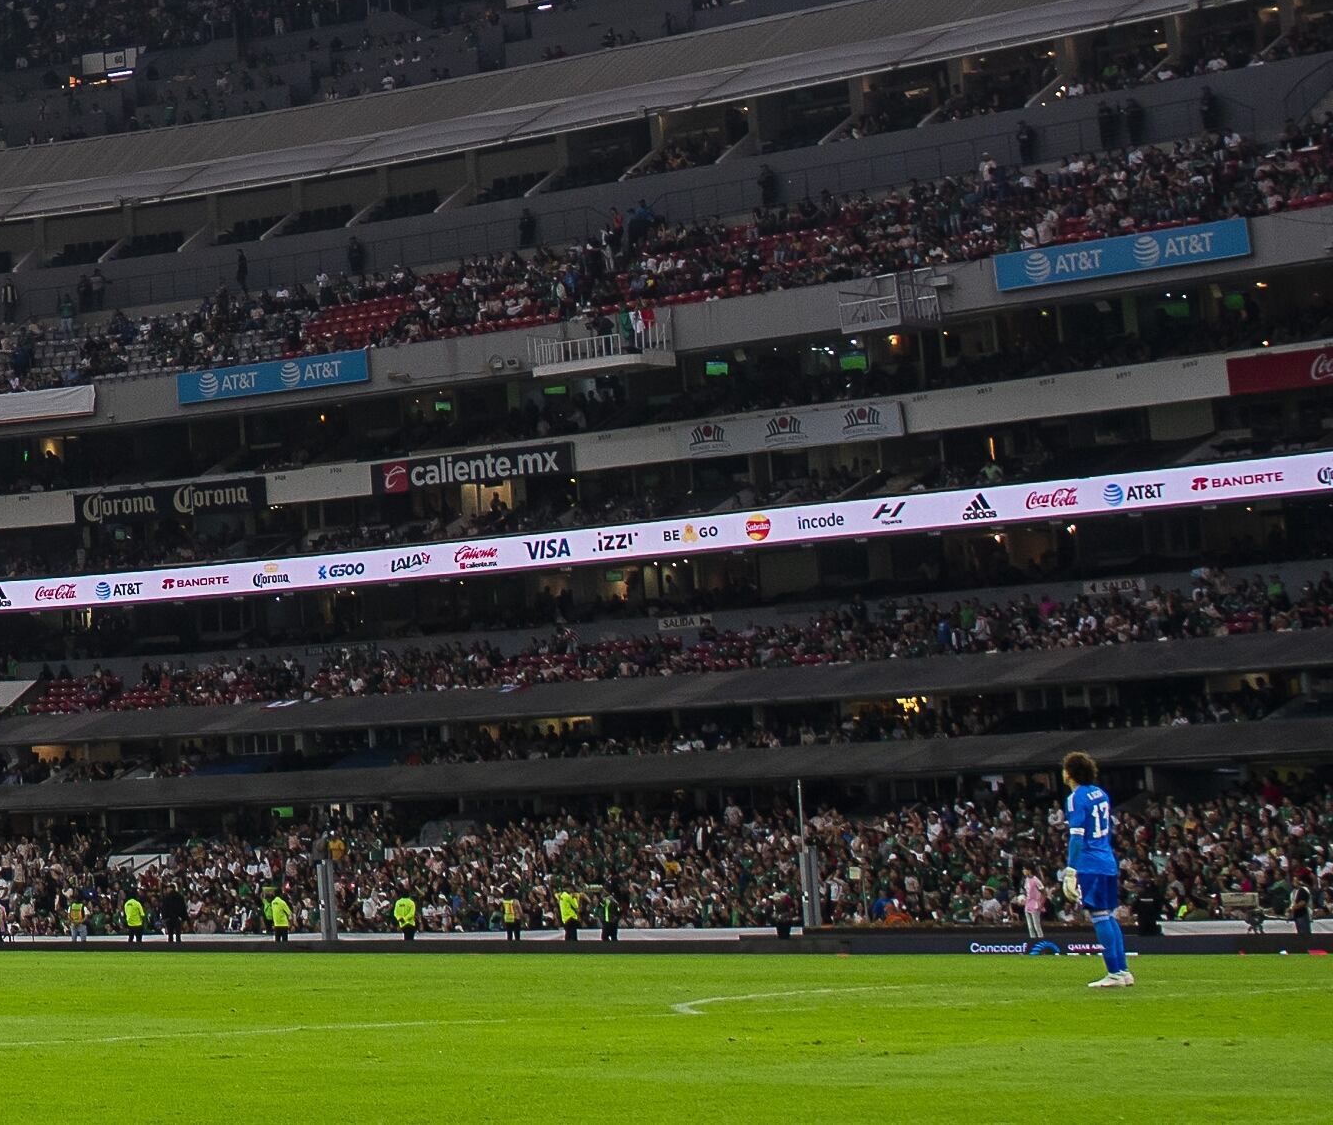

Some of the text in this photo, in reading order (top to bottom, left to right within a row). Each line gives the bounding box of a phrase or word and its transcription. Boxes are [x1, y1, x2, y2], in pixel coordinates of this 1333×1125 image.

[1165, 232, 1213, 257] AT&T
[1055, 249, 1102, 274] AT&T
[304, 361, 341, 381] AT&T
[221, 372, 257, 391] AT&T
[412, 450, 558, 488] caliente.mx
[1212, 472, 1284, 488] BANORTE
[173, 484, 250, 515] Corona
[1127, 483, 1165, 500] AT&T
[83, 495, 156, 523] Corona
[962, 510, 998, 520] adidas
[797, 512, 844, 530] incode
[522, 538, 571, 560] VISA
[329, 563, 365, 577] G500
[113, 582, 143, 597] AT&T
[177, 576, 229, 588] BANORTE
[253, 573, 290, 588] Corona
[663, 619, 695, 628] SALIDA
[1092, 802, 1109, 838] 13
[970, 942, 1028, 954] Concacaf
